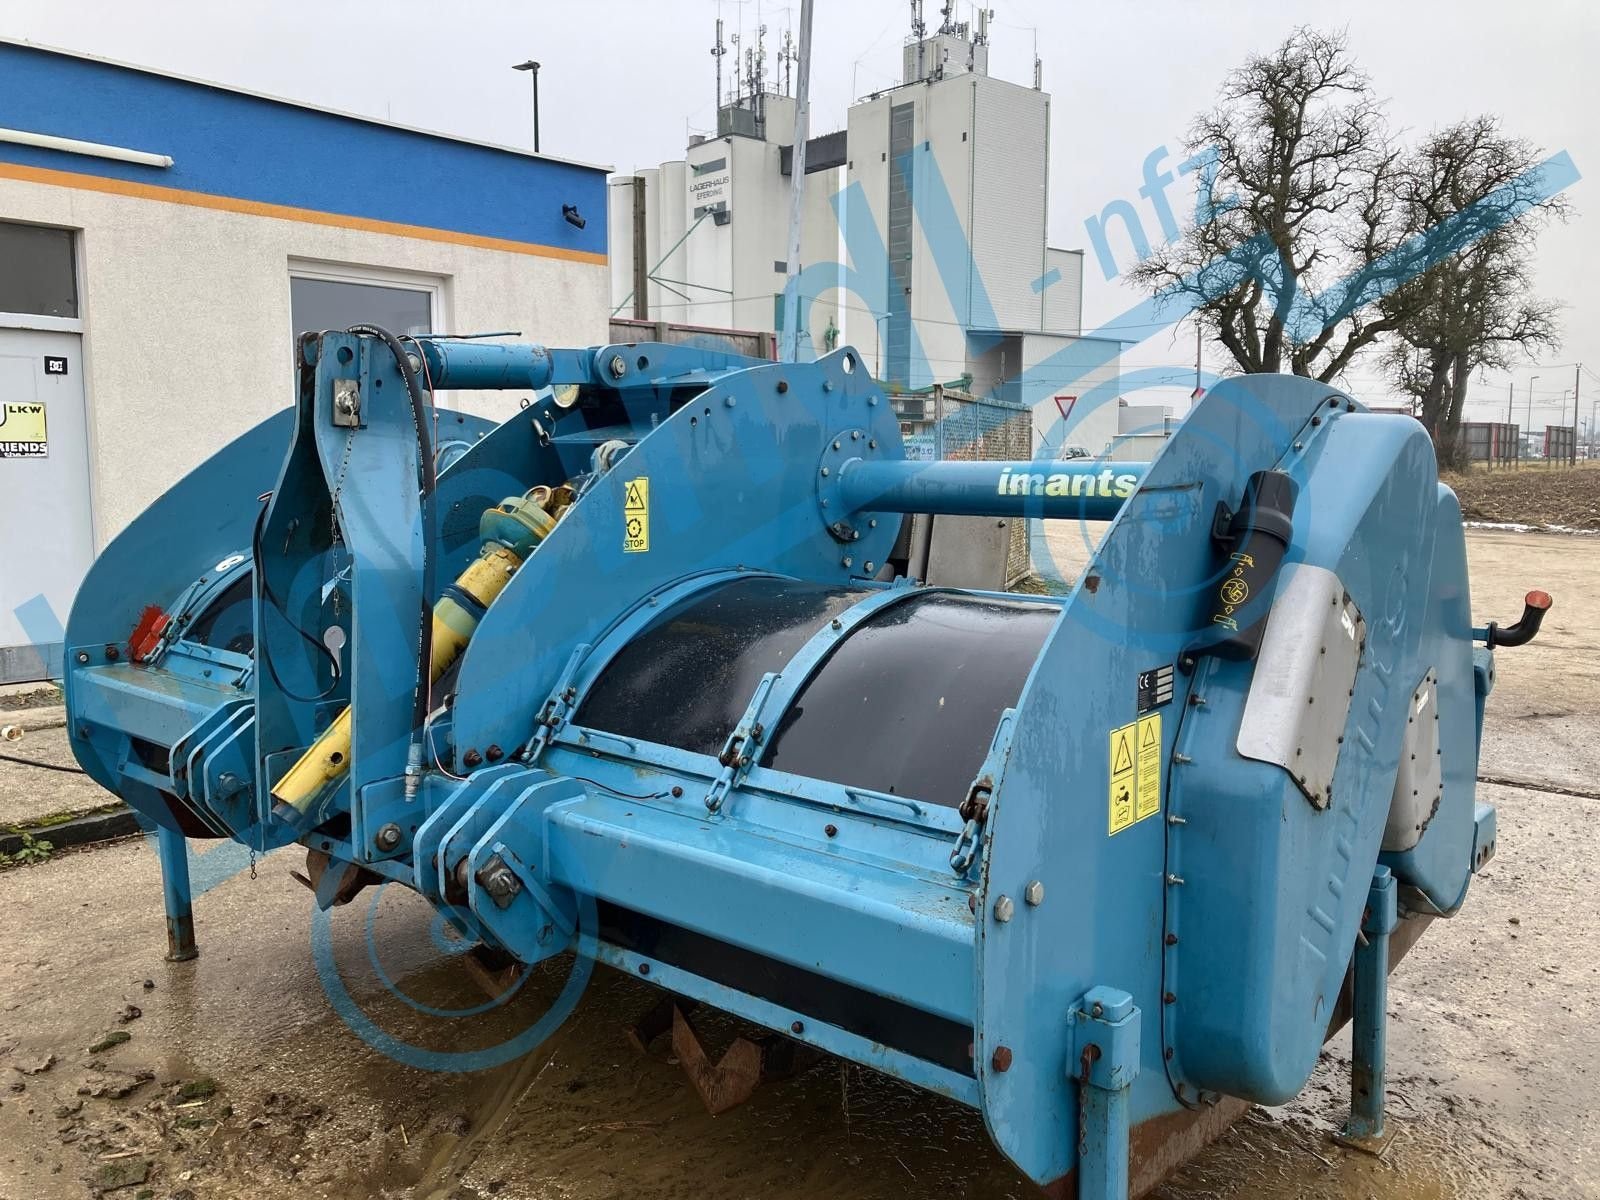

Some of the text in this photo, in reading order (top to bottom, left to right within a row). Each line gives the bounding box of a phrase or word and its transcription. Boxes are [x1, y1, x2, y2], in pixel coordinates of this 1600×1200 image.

[689, 176, 729, 192] LAGERHAUS
[9, 405, 42, 413] LKW
[998, 467, 1137, 497] imants
[624, 540, 645, 548] STOP
